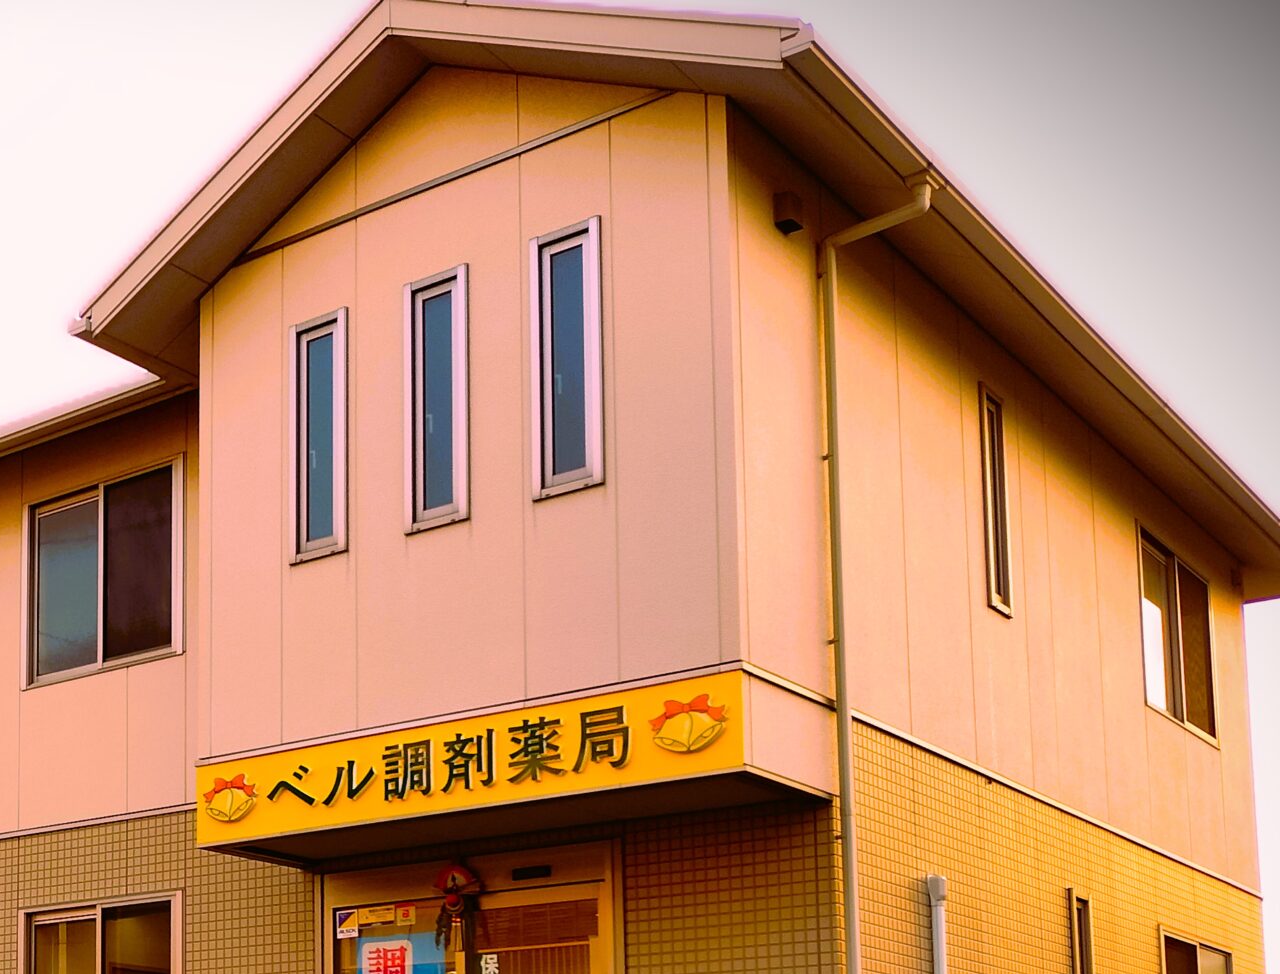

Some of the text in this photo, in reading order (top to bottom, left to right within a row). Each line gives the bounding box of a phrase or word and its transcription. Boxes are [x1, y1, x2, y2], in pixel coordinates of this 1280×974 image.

[266, 704, 632, 808] ベル調剤薬局
